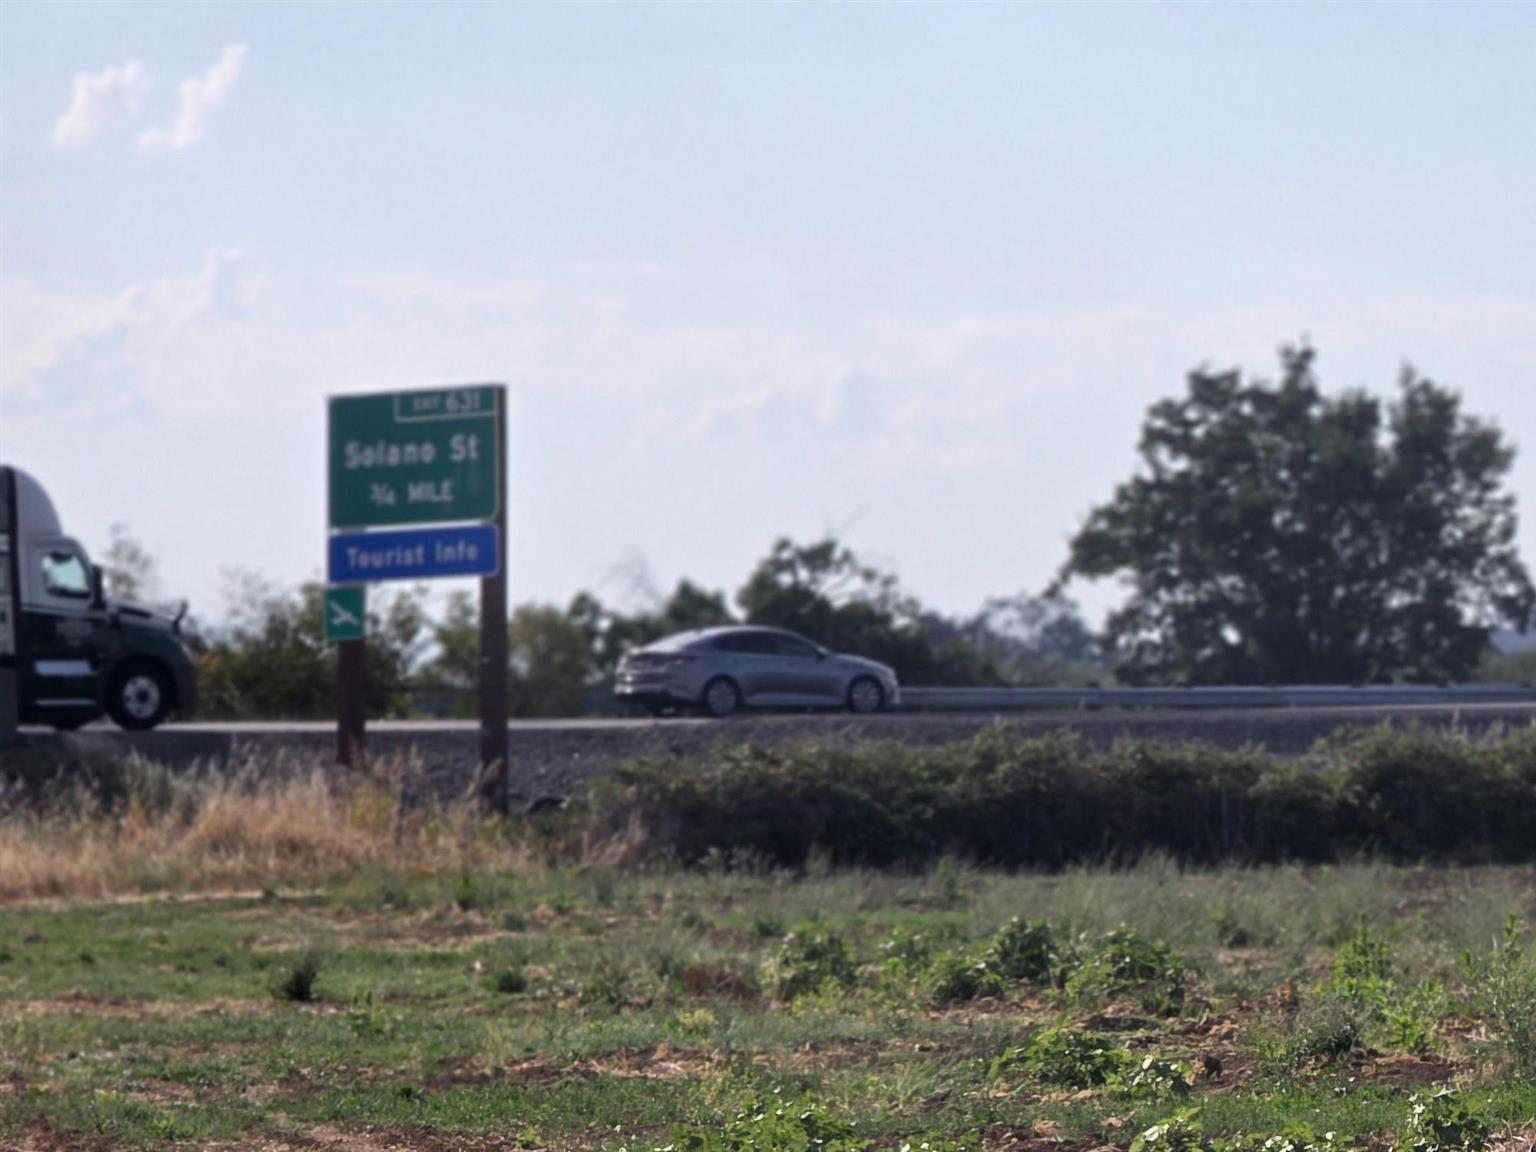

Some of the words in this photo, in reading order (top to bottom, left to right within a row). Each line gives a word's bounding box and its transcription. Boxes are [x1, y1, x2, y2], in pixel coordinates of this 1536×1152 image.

[345, 440, 436, 469] Solano
[450, 433, 480, 462] St
[408, 480, 455, 504] MILE
[346, 546, 424, 569] Tourist
[435, 539, 479, 562] Info
